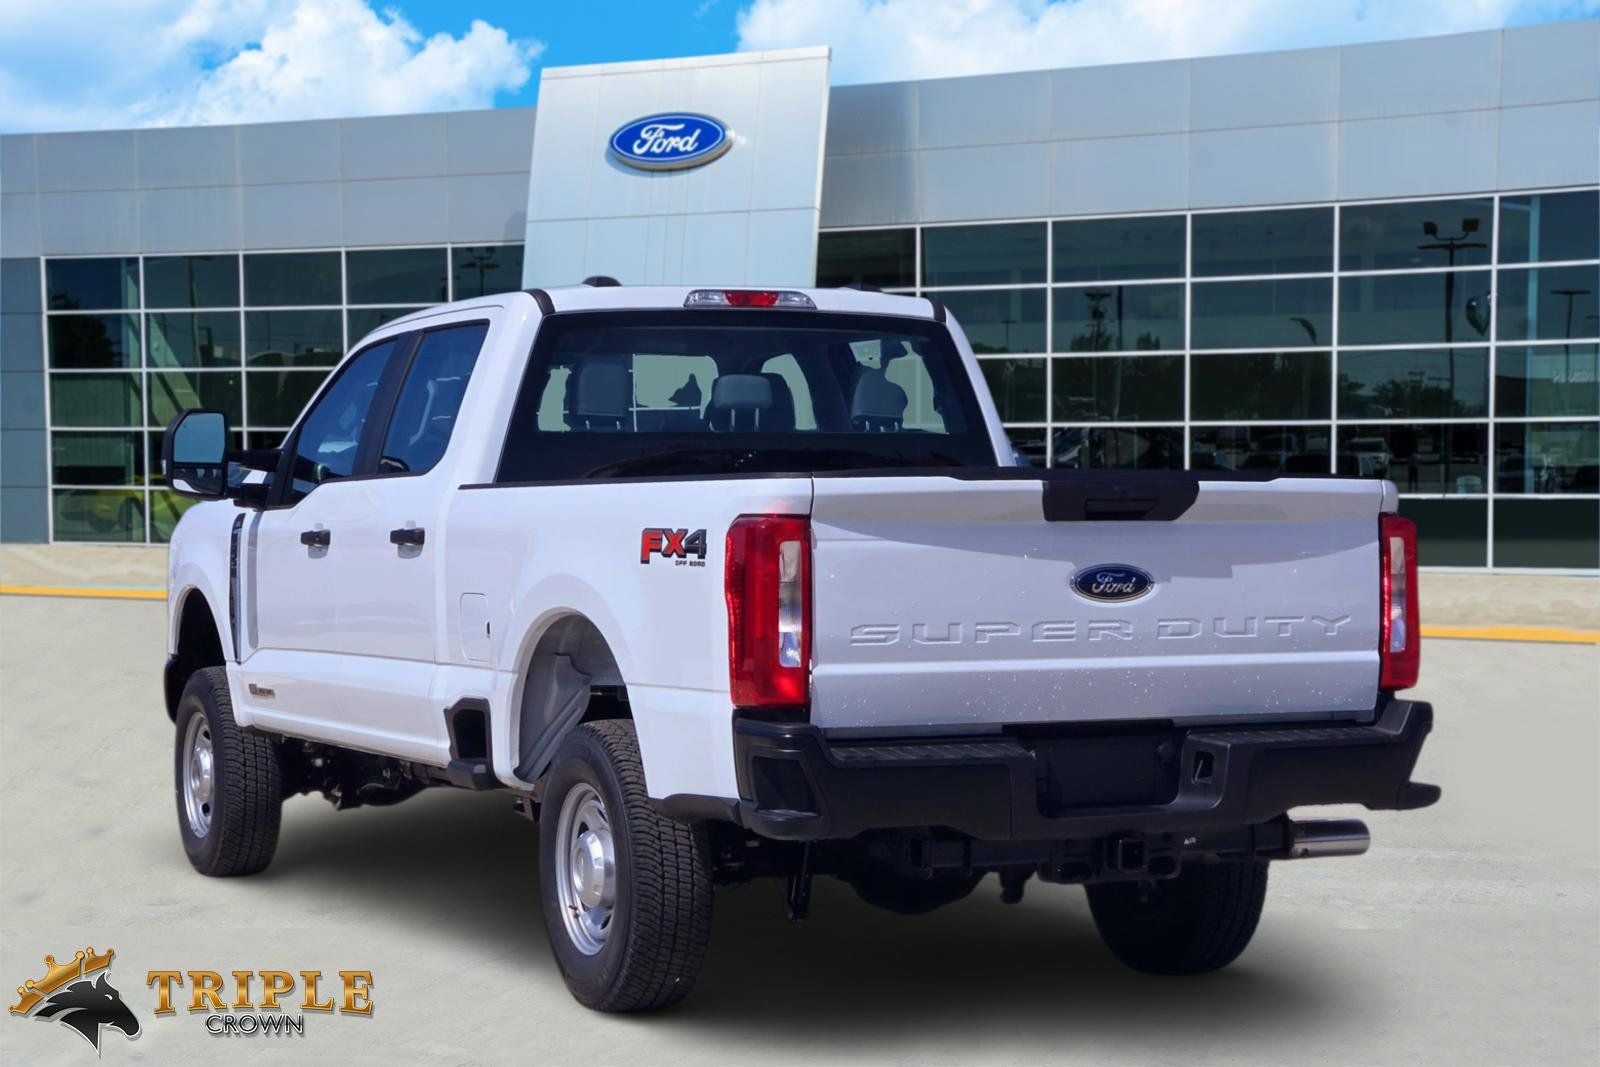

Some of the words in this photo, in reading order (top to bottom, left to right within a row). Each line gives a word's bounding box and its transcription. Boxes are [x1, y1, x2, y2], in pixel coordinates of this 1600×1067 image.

[632, 123, 701, 155] Ford
[640, 528, 707, 564] FX4
[1091, 572, 1136, 593] Ford
[851, 619, 1134, 646] SUPER
[1157, 615, 1351, 640] DUTY
